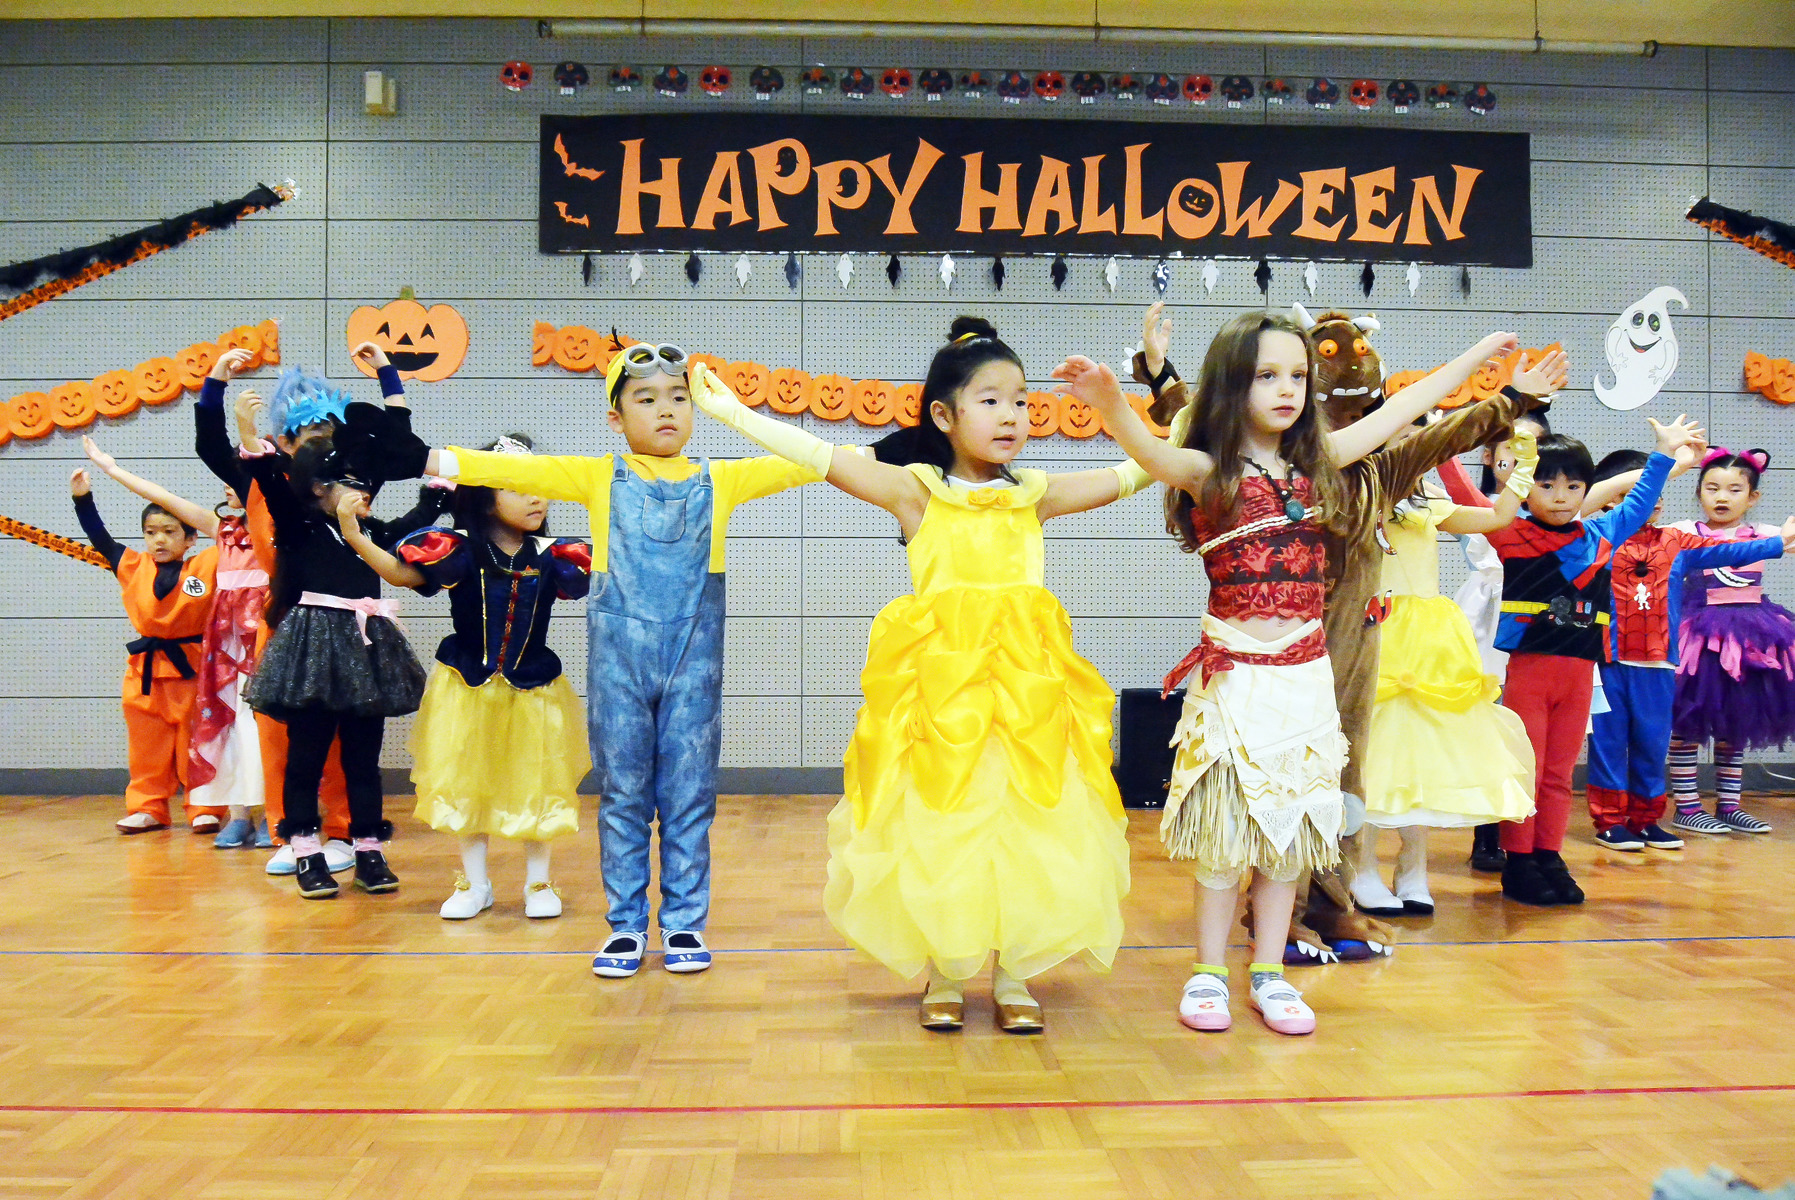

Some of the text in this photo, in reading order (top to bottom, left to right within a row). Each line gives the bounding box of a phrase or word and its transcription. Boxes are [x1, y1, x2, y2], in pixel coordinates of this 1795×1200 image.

[614, 136, 1484, 246] HAPPY HALLOWEEN
[185, 578, 204, 595] 悟
